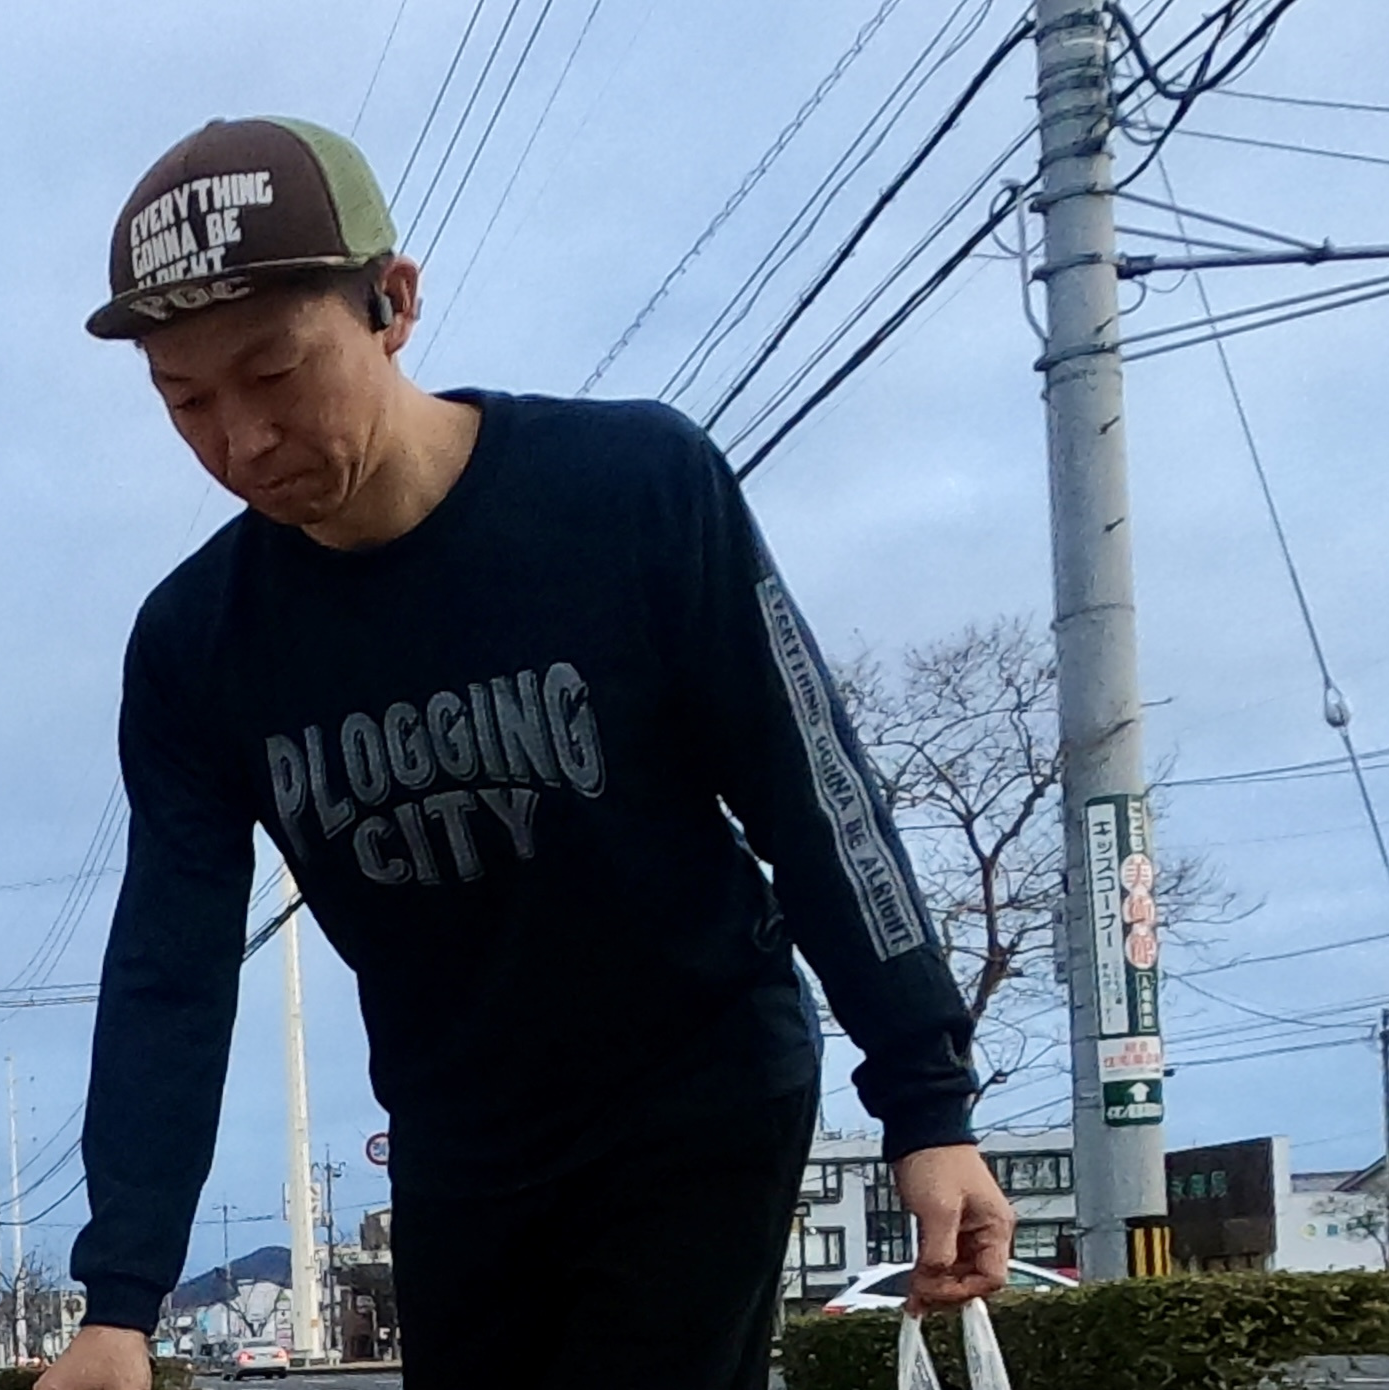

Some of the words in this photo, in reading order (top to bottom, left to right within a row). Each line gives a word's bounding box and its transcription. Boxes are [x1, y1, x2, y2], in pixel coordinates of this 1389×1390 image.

[130, 171, 274, 248] EVERYTHING
[131, 220, 199, 279] GONNA
[206, 208, 242, 247] BE
[265, 661, 607, 860] PLOGGING
[352, 787, 540, 885] CITY
[859, 856, 913, 947] ALRIGHT
